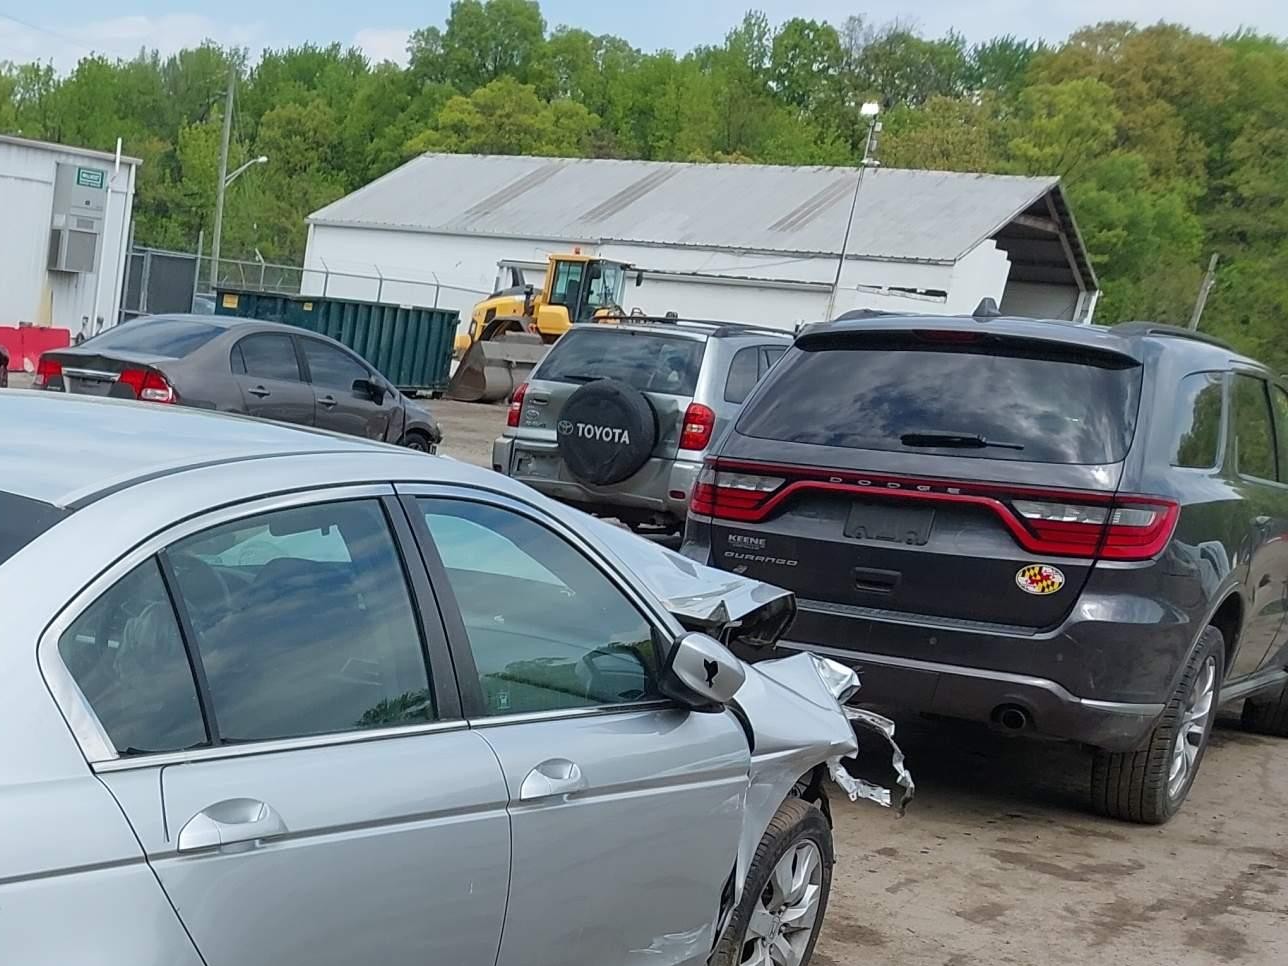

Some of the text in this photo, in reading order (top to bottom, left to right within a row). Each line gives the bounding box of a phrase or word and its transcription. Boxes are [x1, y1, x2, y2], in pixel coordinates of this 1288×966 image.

[576, 422, 630, 445] TOYOTA
[829, 476, 960, 495] DODGE
[727, 534, 767, 549] KEENE
[723, 551, 799, 567] DURANGO
